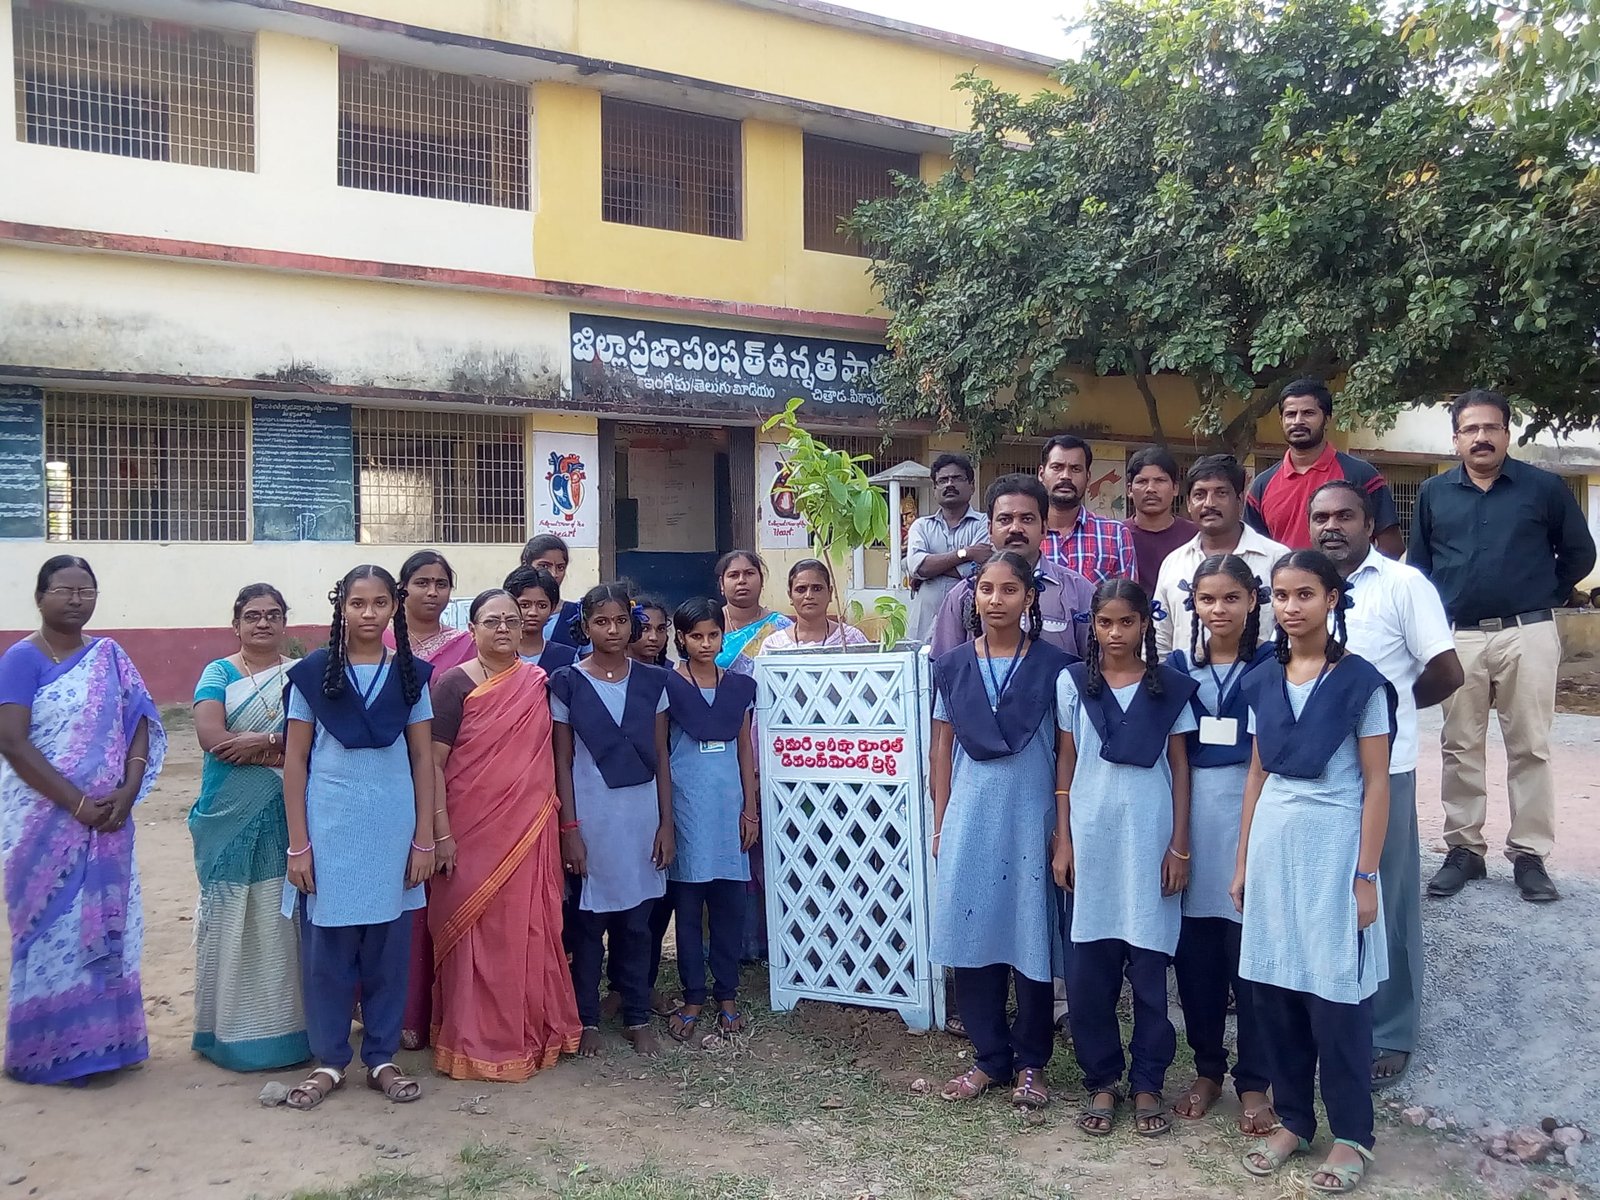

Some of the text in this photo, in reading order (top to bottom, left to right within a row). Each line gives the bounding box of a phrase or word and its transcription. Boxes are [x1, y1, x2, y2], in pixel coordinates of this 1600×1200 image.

[571, 326, 628, 367] జిల్లా
[628, 330, 681, 375] ప్రజా
[682, 336, 766, 379] పరిషత్
[767, 341, 838, 390] ఉన్నత
